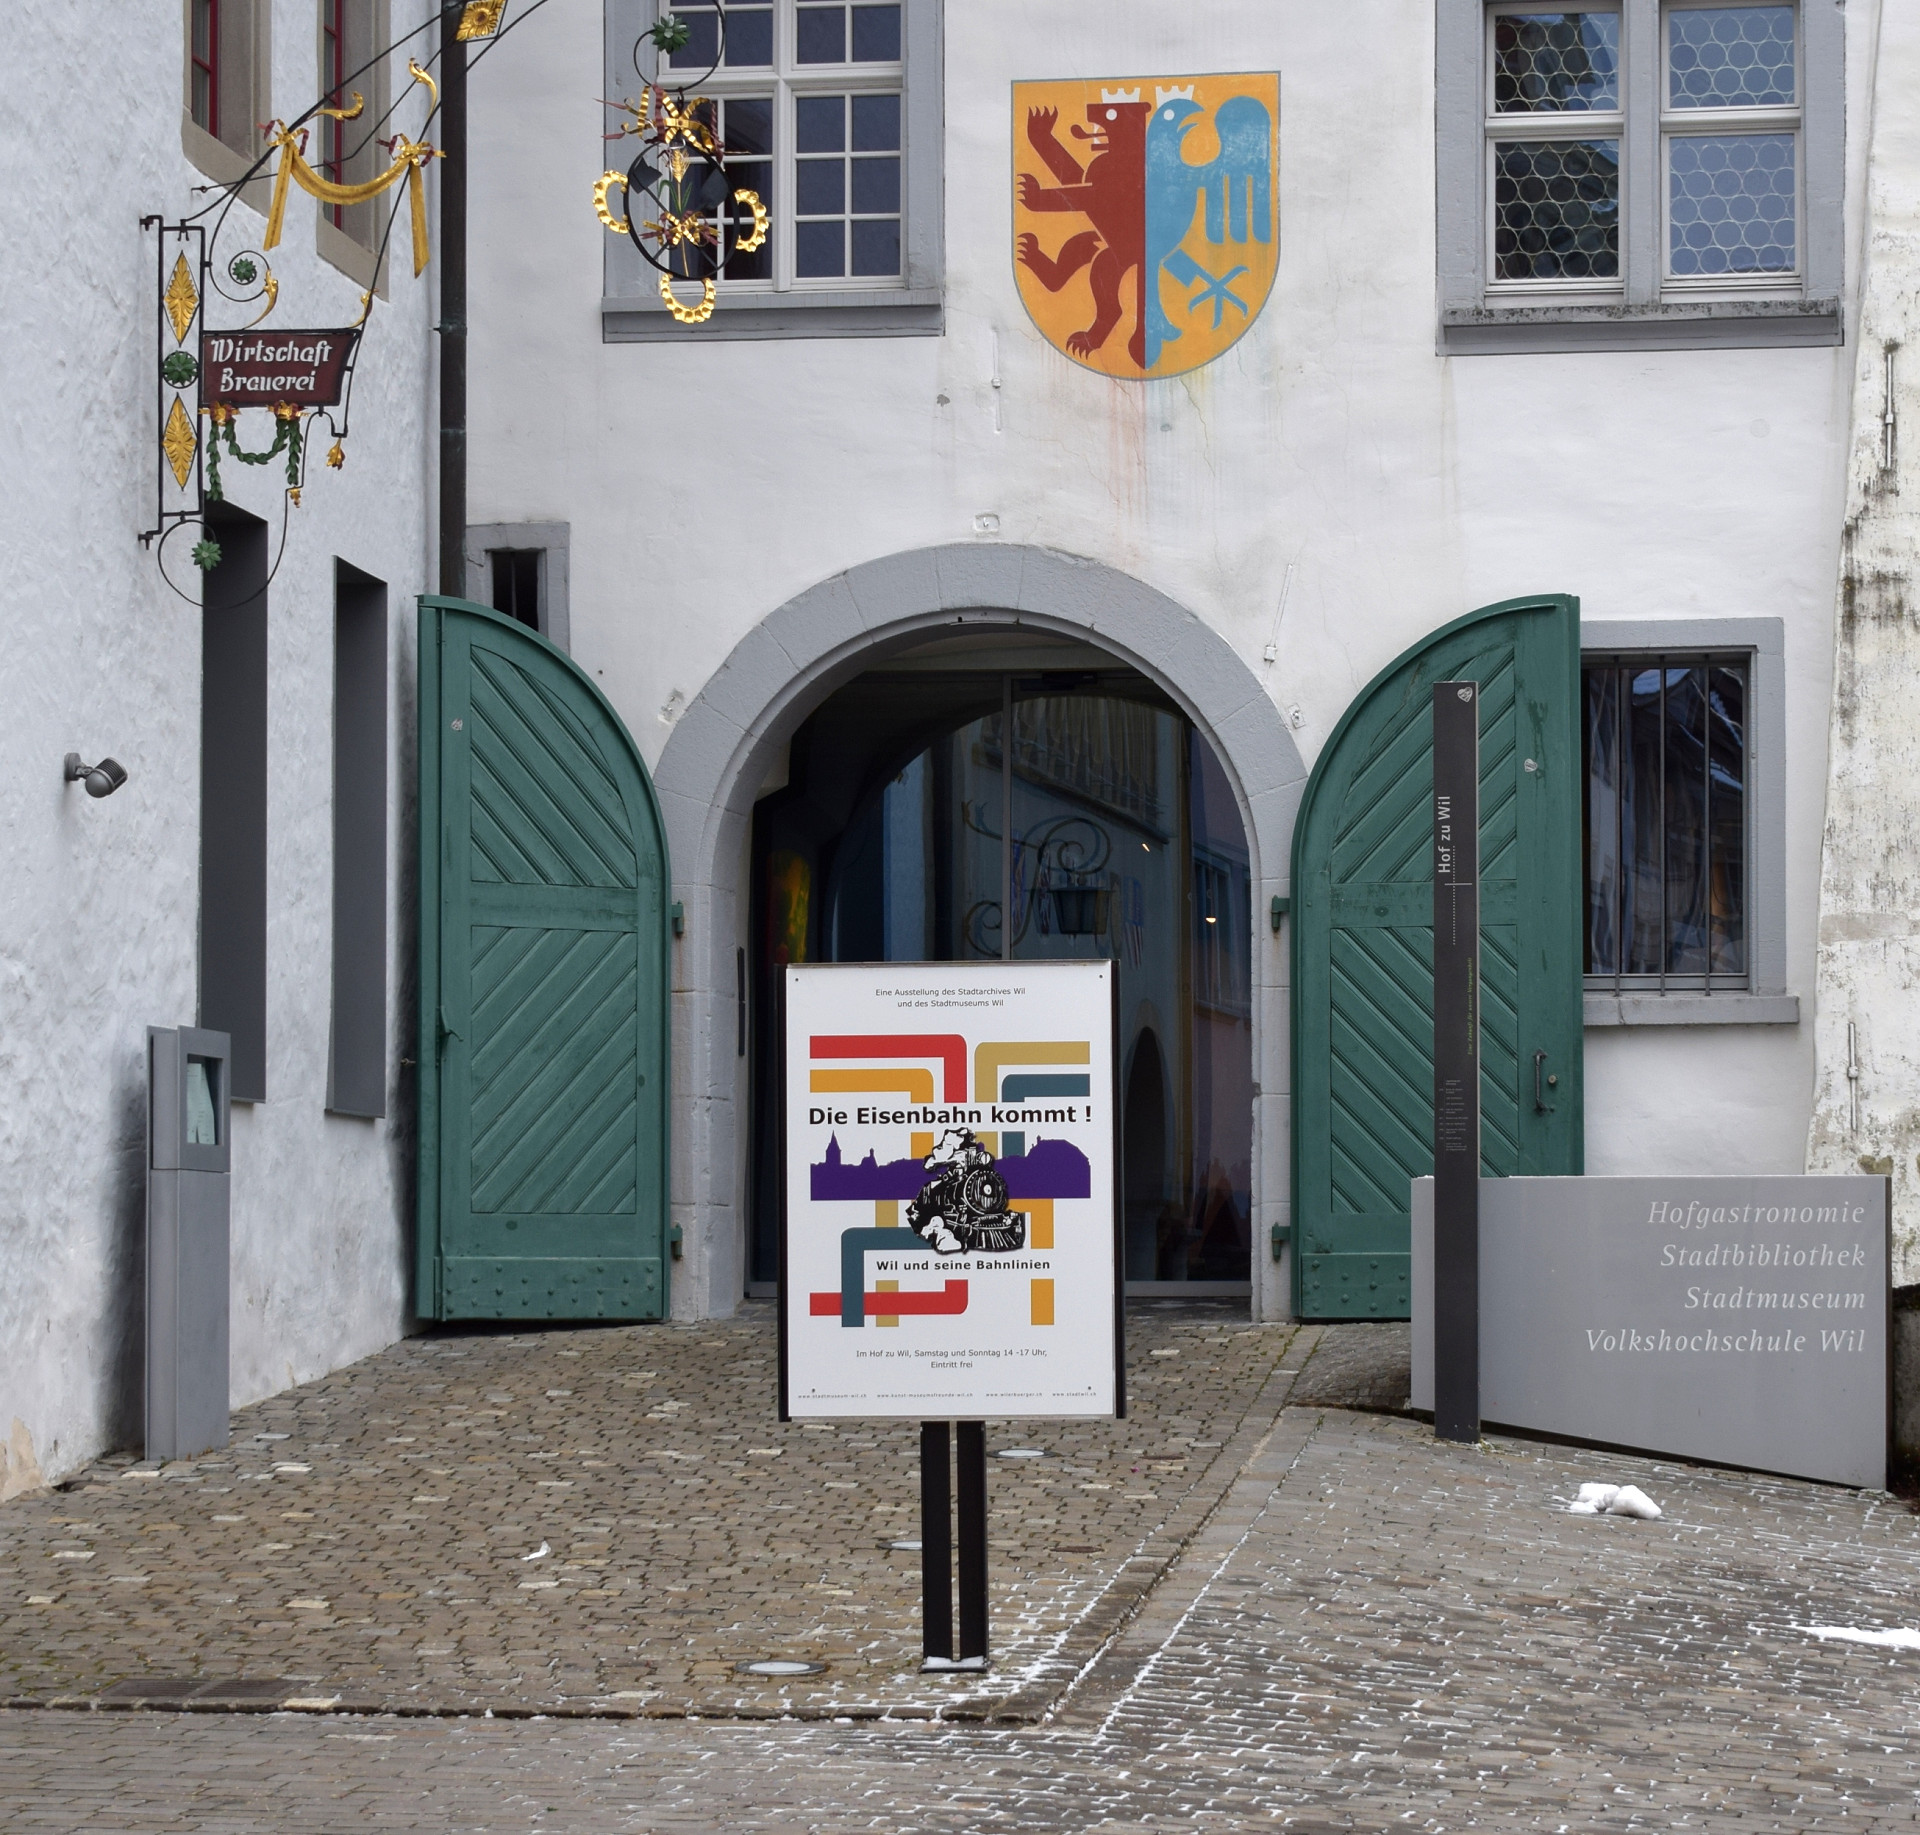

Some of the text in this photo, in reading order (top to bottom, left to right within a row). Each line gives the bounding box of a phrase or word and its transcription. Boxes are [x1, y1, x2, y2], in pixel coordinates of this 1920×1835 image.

[211, 339, 333, 366] Wirtschaft
[220, 368, 316, 392] Brauerei
[1438, 796, 1451, 872] Hof zu Wil
[894, 988, 940, 996] Ausstellung
[958, 988, 1011, 996] Stadtarchives
[808, 1106, 1092, 1124] Die Eisenbahn kommt !
[1648, 1200, 1865, 1229] Hofgastronomie
[876, 1260, 1050, 1270] Wil und seine Bahnlinien
[1660, 1244, 1865, 1266] Stadtbibliothek
[1684, 1286, 1865, 1309] Stadtmuseum
[1586, 1329, 1865, 1352] Volkshochschule Wil
[897, 1350, 912, 1358] Wil,
[914, 1350, 948, 1358] Samstag
[968, 1350, 1000, 1358] Sonntag
[1032, 1348, 1048, 1357] Uhr,
